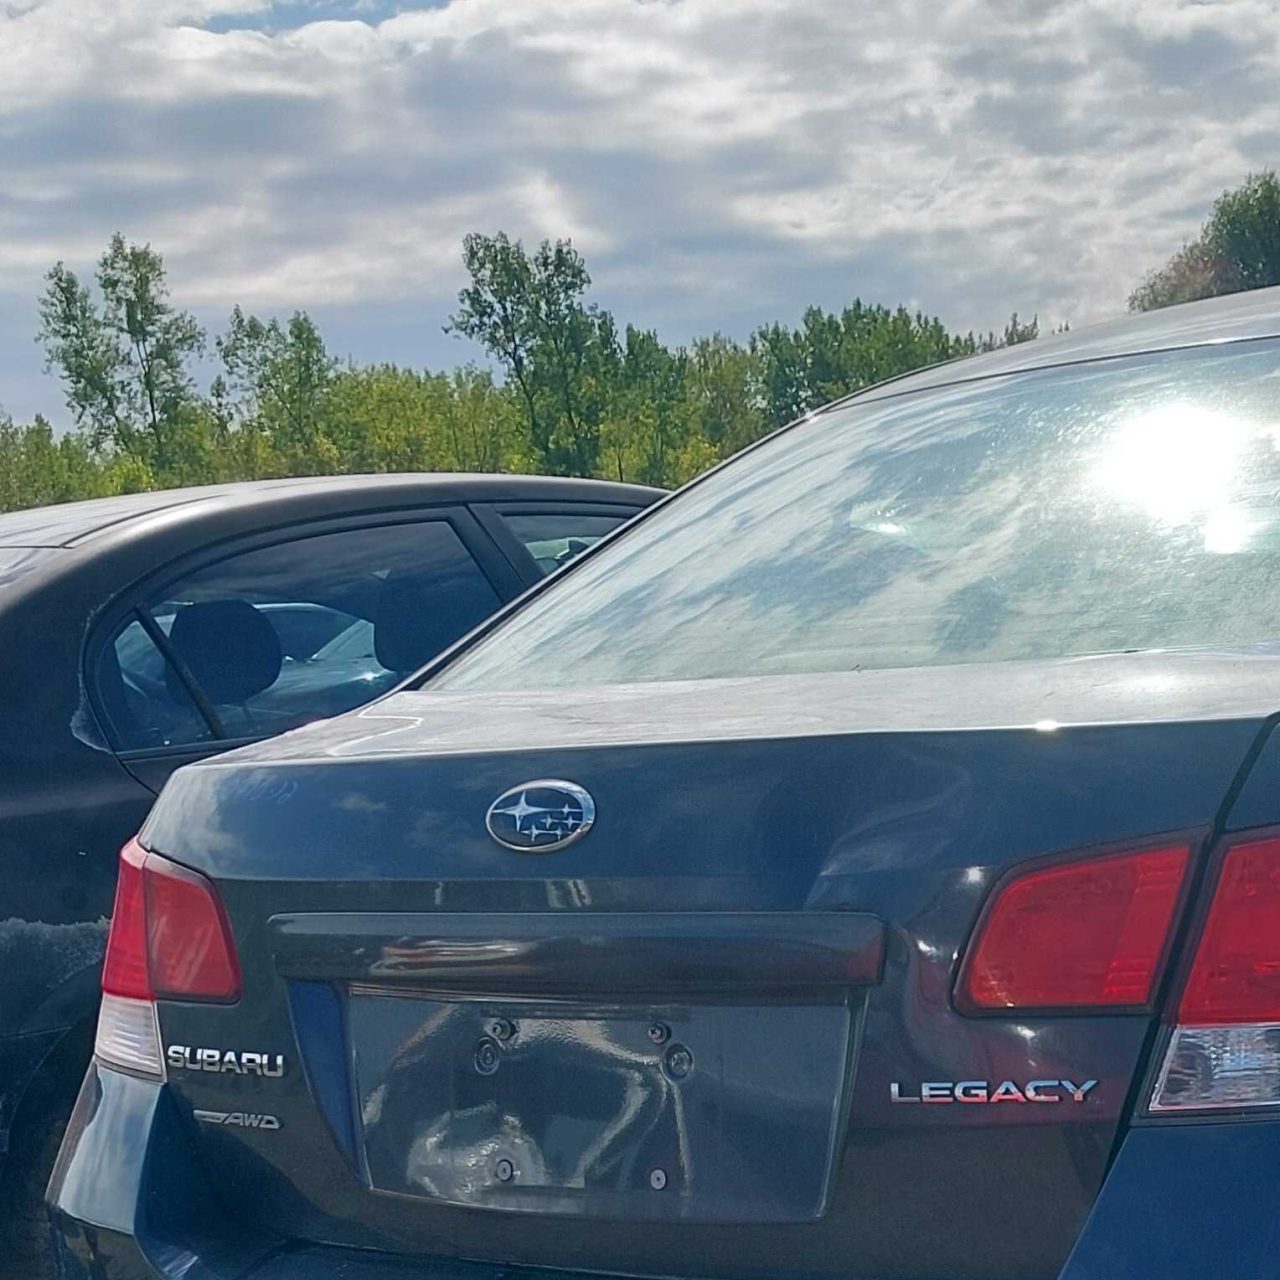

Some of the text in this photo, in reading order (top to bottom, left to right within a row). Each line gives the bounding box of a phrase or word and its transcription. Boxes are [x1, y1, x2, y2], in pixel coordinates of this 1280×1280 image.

[167, 1044, 284, 1078] SUBARU
[889, 1079, 1099, 1103] LEGACY
[223, 1111, 282, 1130] AWD
